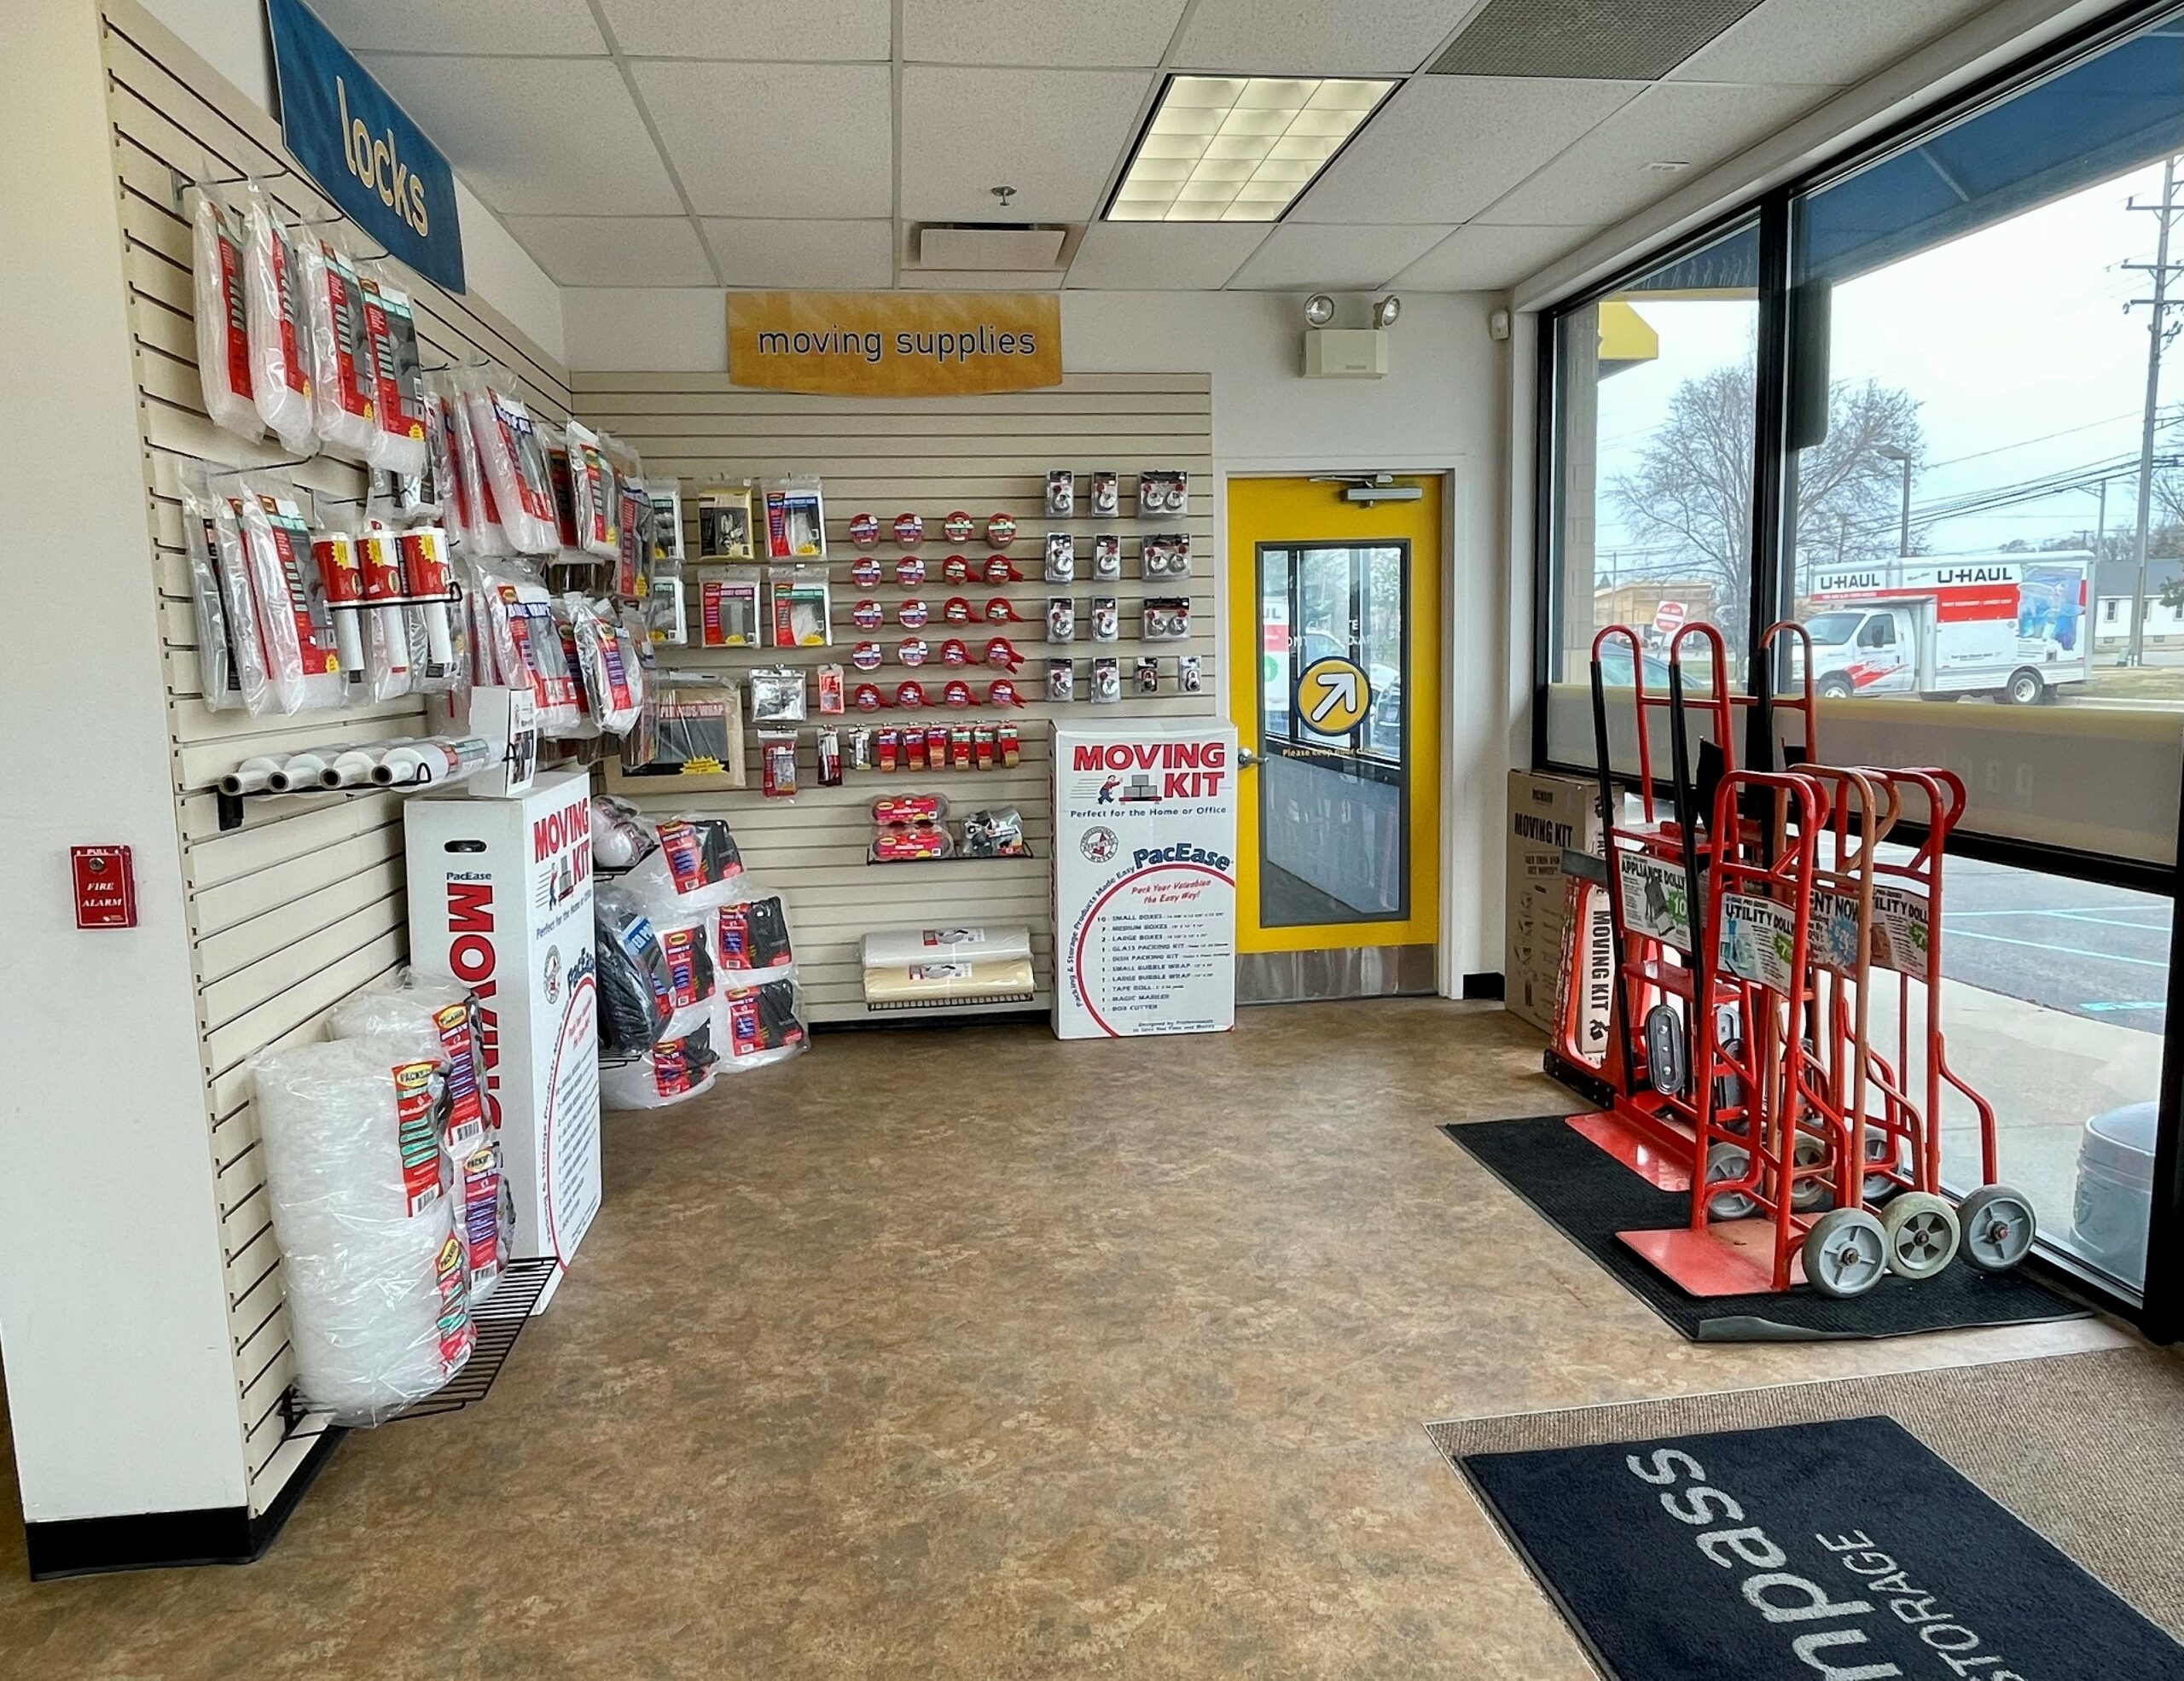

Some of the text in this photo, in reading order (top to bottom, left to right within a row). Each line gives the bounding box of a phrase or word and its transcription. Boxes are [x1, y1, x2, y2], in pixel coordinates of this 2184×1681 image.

[336, 75, 429, 238] locks
[758, 324, 1036, 363] moving supplies
[1937, 567, 2013, 583] U-HAUL
[1073, 742, 1225, 771] MOVING
[1283, 748, 1310, 758] Please
[1164, 771, 1225, 798] KIT
[1071, 810, 1107, 818] Perfect
[1110, 809, 1125, 817] for
[1129, 808, 1146, 817] the
[1149, 807, 1178, 816] Home
[533, 797, 589, 864] MOVING
[1514, 812, 1573, 847] MOVING KIT
[572, 839, 590, 886] KIT
[1133, 843, 1230, 871] PacEase
[87, 881, 114, 891] FIRE
[446, 872, 492, 881] PacEase
[82, 899, 122, 907] ALARM
[1159, 894, 1179, 904] Easy
[1674, 897, 1687, 916] 10
[1809, 890, 1833, 915] NT
[1872, 896, 1929, 924] ILITY DOLL
[1066, 932, 1078, 964] Storage
[1073, 894, 1097, 930] Products
[1095, 877, 1116, 896] Made
[1116, 865, 1136, 880] Easy
[1726, 903, 1774, 926] UTILITY
[1590, 910, 1611, 1011] MOVING KIT
